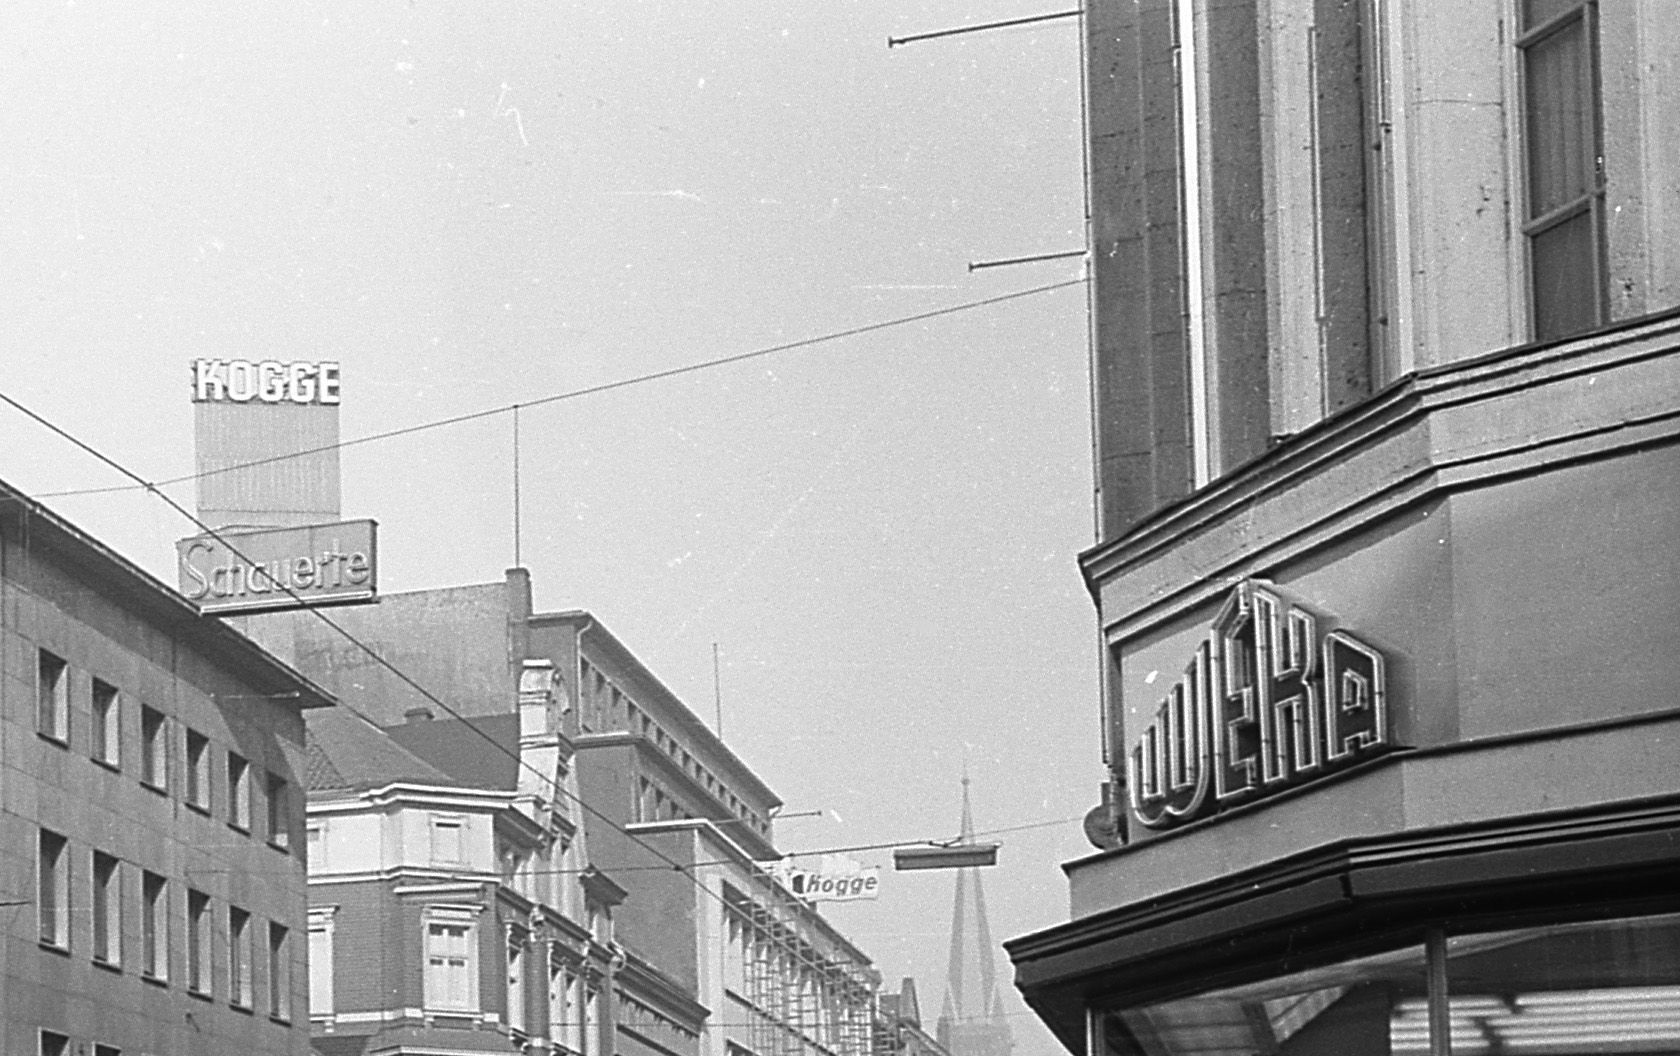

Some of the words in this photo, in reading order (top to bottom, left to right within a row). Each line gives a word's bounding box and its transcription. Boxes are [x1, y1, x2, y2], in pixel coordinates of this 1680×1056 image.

[193, 358, 340, 404] KOGGE
[182, 538, 370, 599] Schauerte
[1129, 580, 1386, 827] WEKA
